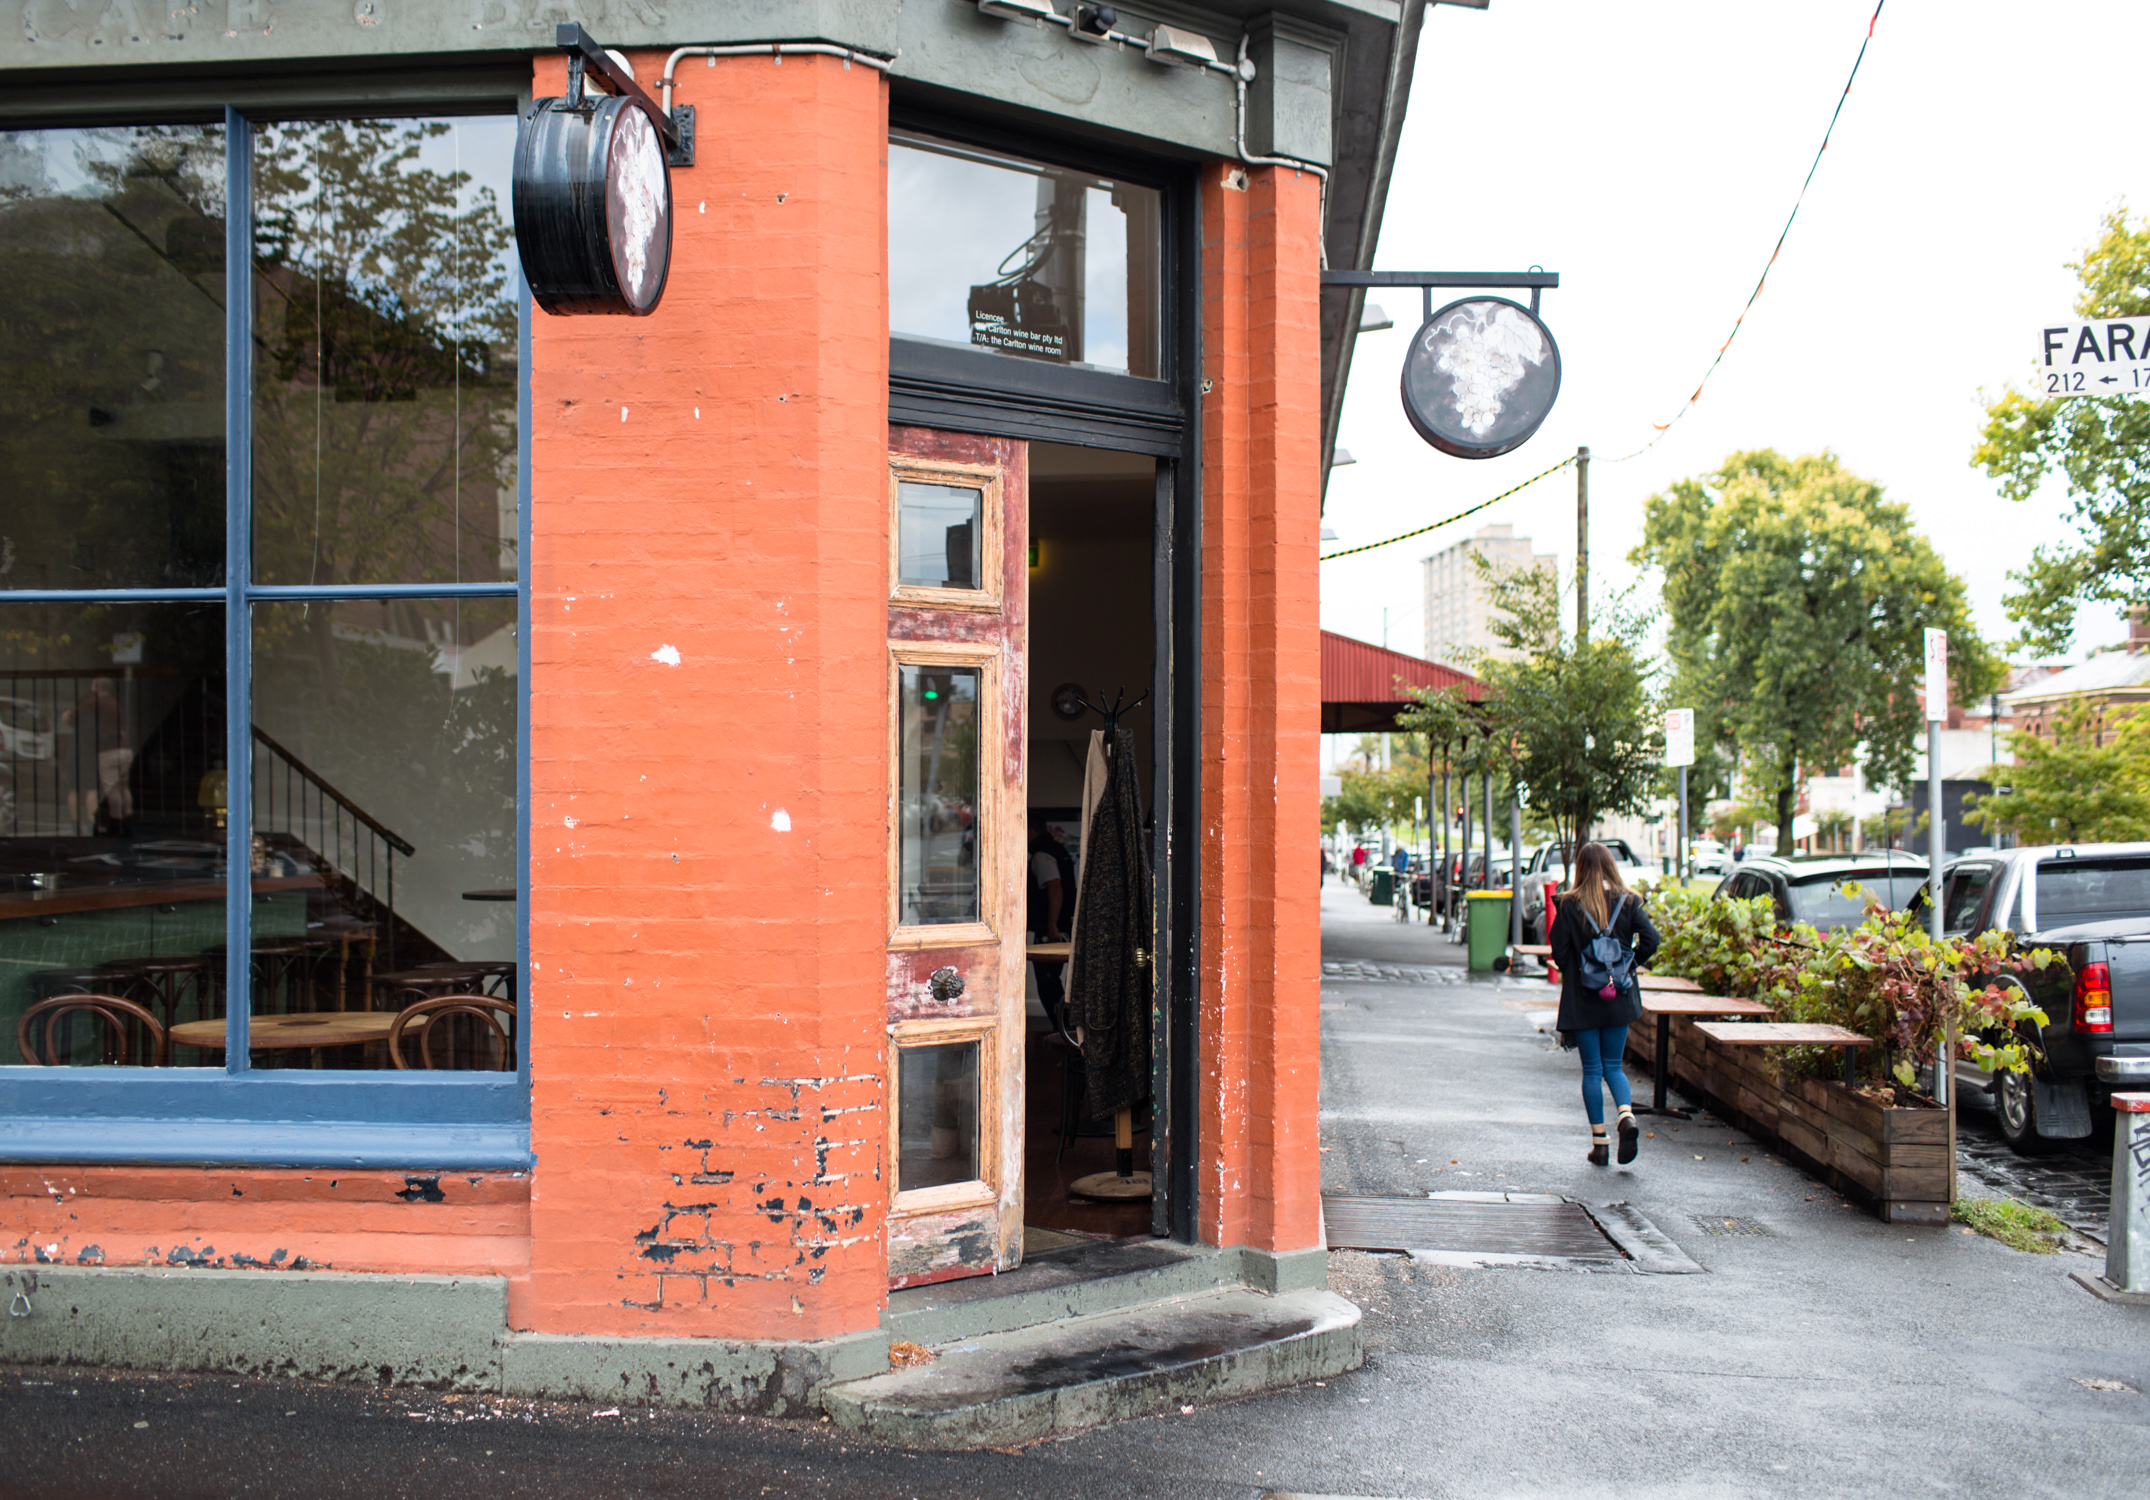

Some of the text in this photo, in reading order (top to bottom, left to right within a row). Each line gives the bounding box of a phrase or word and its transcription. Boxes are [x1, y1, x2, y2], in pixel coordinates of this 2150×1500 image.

[988, 323, 1012, 336] Carlton
[1013, 329, 1029, 339] wine
[1030, 331, 1042, 341] bar
[1042, 335, 1053, 344] pty
[1054, 336, 1063, 345] ltd
[991, 336, 1002, 345] the
[1003, 338, 1027, 350] Carlton
[1028, 343, 1044, 353] wine
[1045, 345, 1062, 356] room
[2047, 371, 2085, 393] 212
